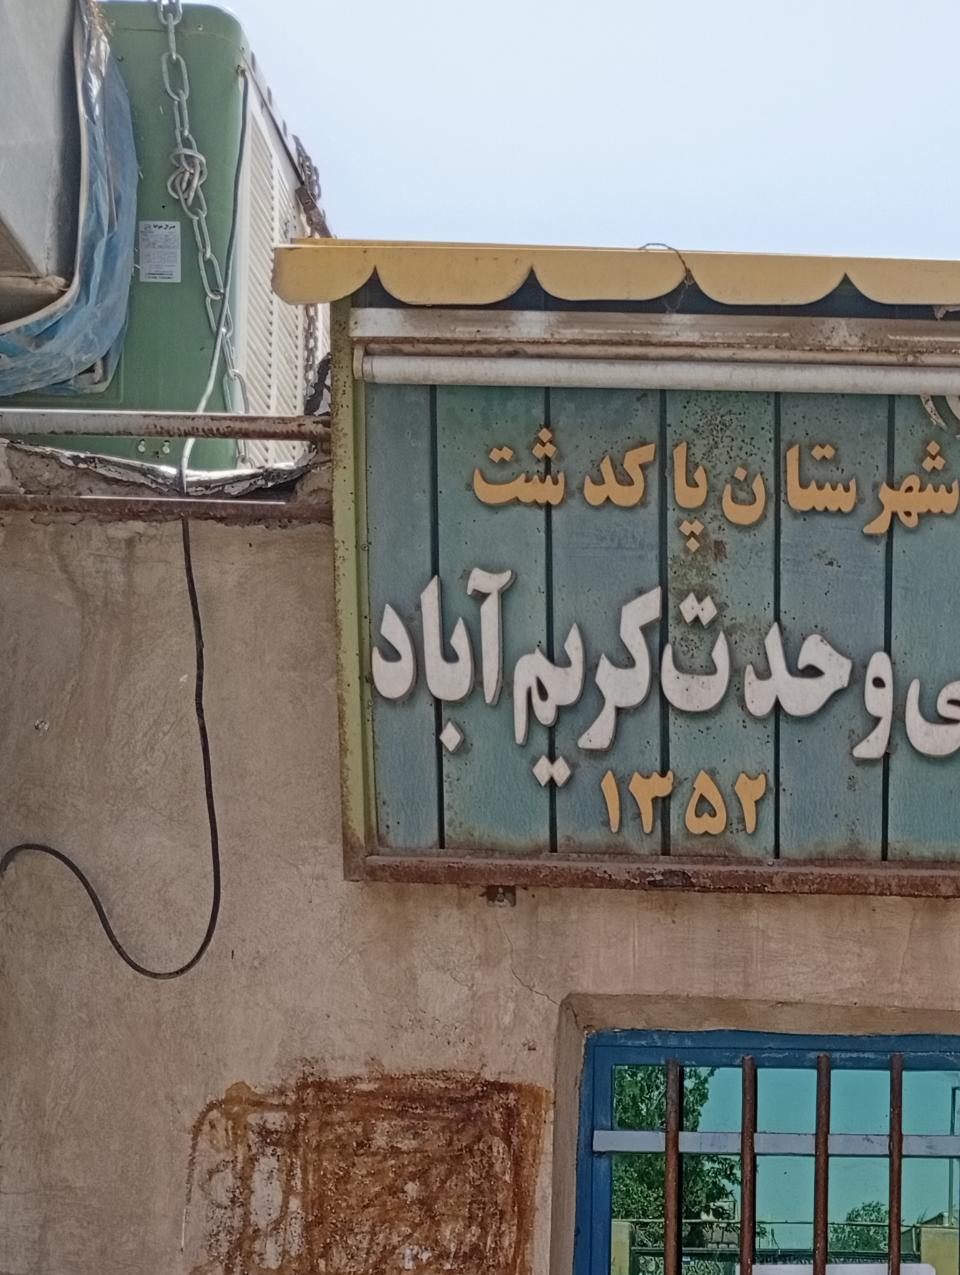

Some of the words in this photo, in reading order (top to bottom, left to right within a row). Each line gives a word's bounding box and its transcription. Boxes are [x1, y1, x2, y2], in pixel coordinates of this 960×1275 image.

[472, 427, 710, 552] پاکدشت
[721, 440, 960, 536] شهرستان
[513, 585, 662, 789] کریم
[660, 592, 894, 760] وحدت
[600, 769, 768, 835] ۱۳۵۲
